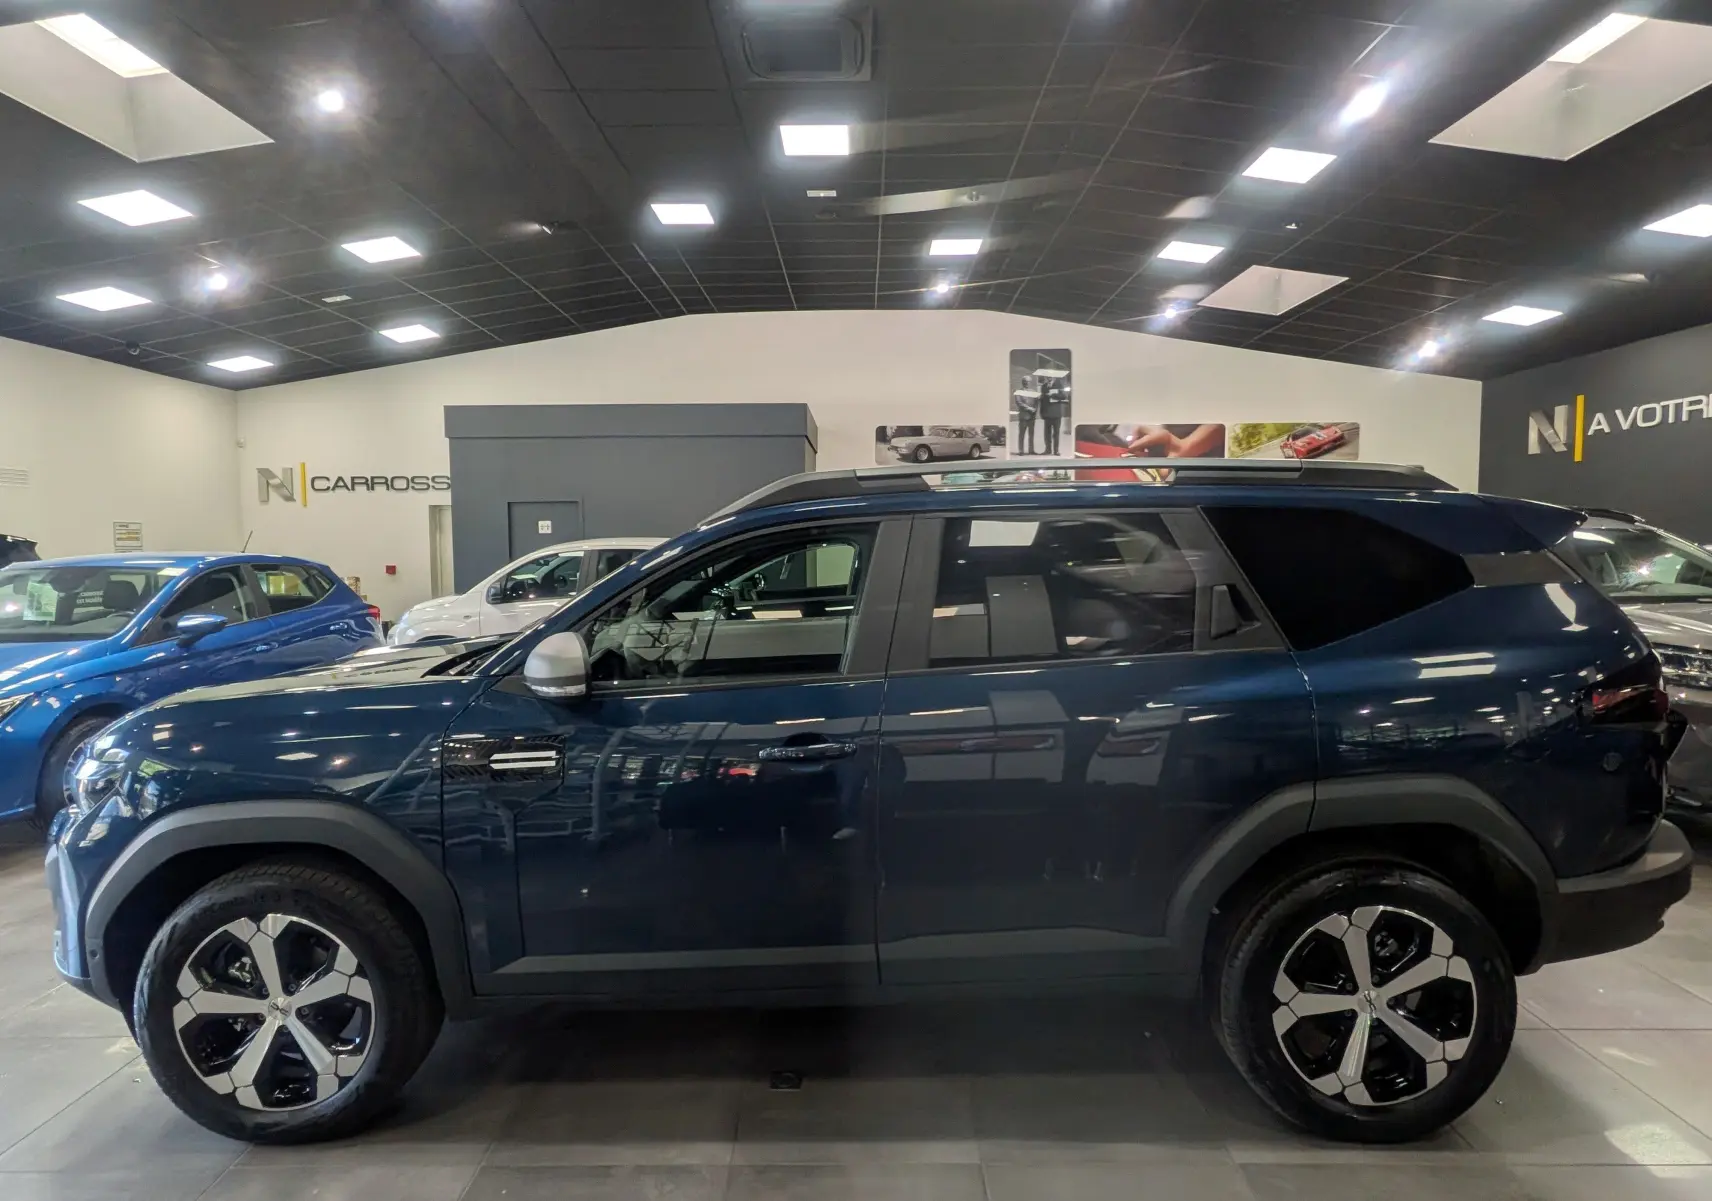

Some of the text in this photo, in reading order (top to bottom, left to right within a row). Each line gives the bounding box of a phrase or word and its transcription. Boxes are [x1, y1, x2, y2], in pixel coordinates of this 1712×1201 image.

[1587, 412, 1611, 436] A
[1615, 393, 1712, 431] VOTR
[310, 475, 451, 492] CARROSS
